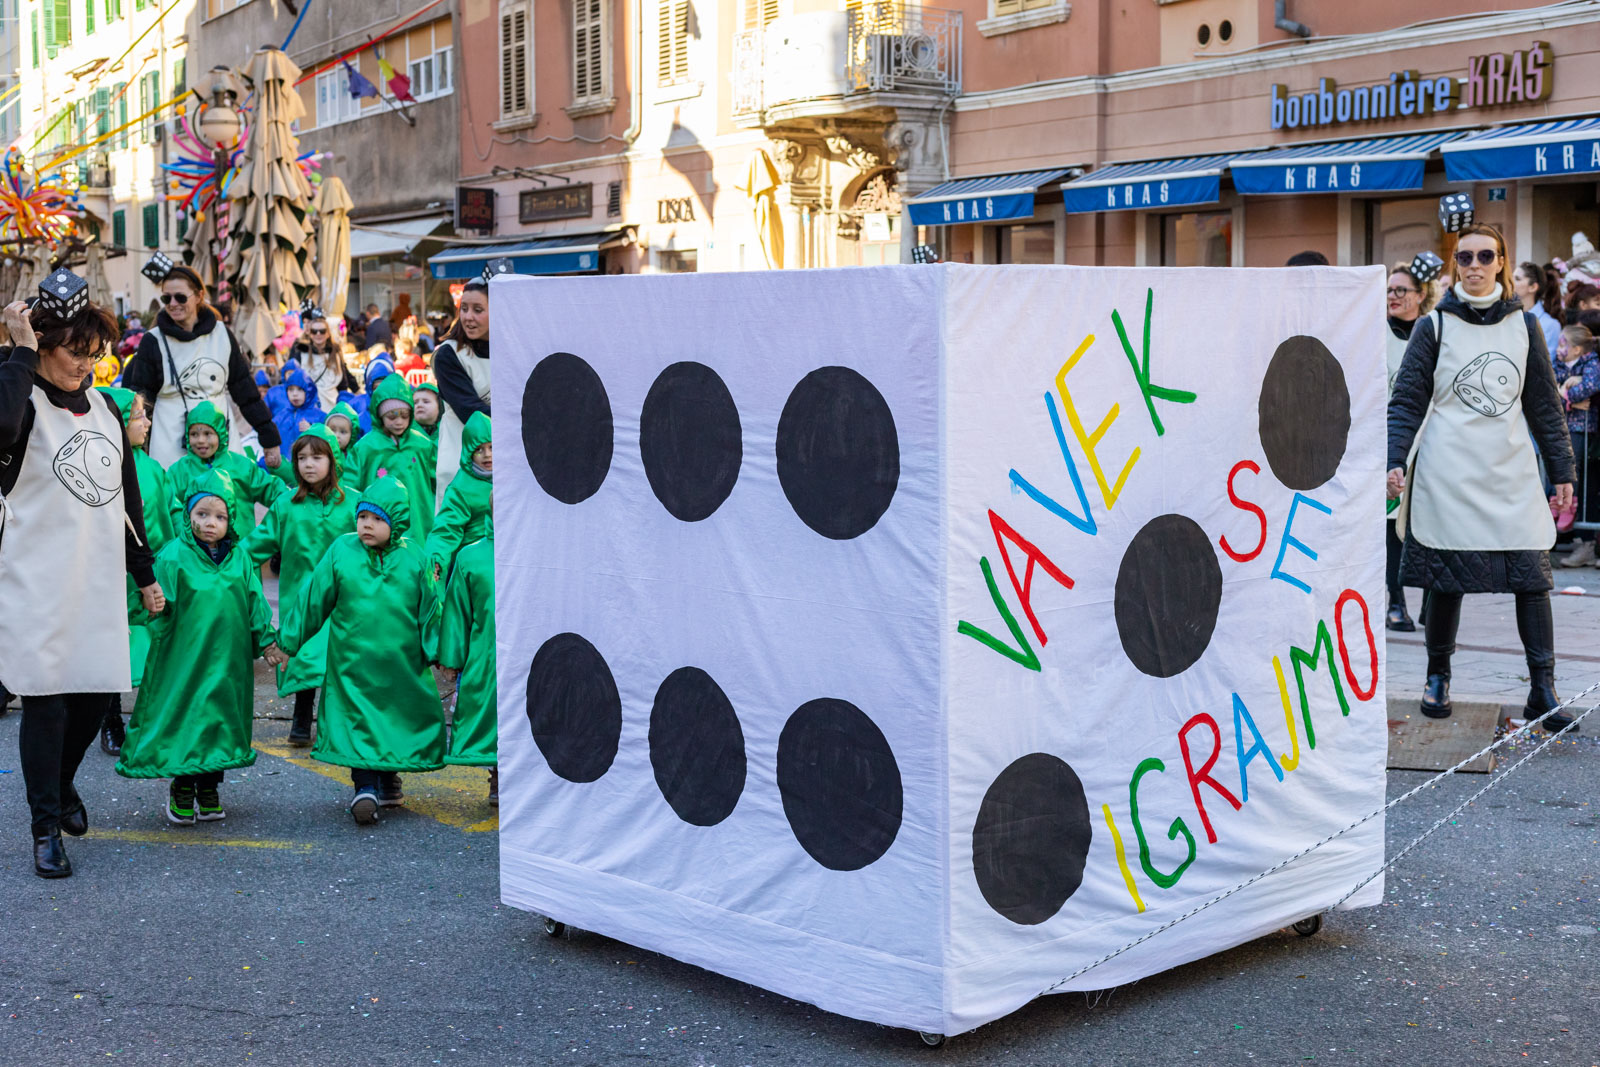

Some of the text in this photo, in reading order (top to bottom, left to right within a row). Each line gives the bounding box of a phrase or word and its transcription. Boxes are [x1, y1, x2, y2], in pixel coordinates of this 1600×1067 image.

[1271, 41, 1548, 130] bonbonnière KRAŠ
[1107, 180, 1169, 207] KRAŠ
[1285, 161, 1361, 190] KRAŠ
[656, 197, 697, 224] LISCA
[943, 196, 993, 221] KRAŠ
[958, 287, 1197, 672] VAVEK
[1219, 459, 1333, 595] SE
[1102, 588, 1379, 914] IGRAJMO
